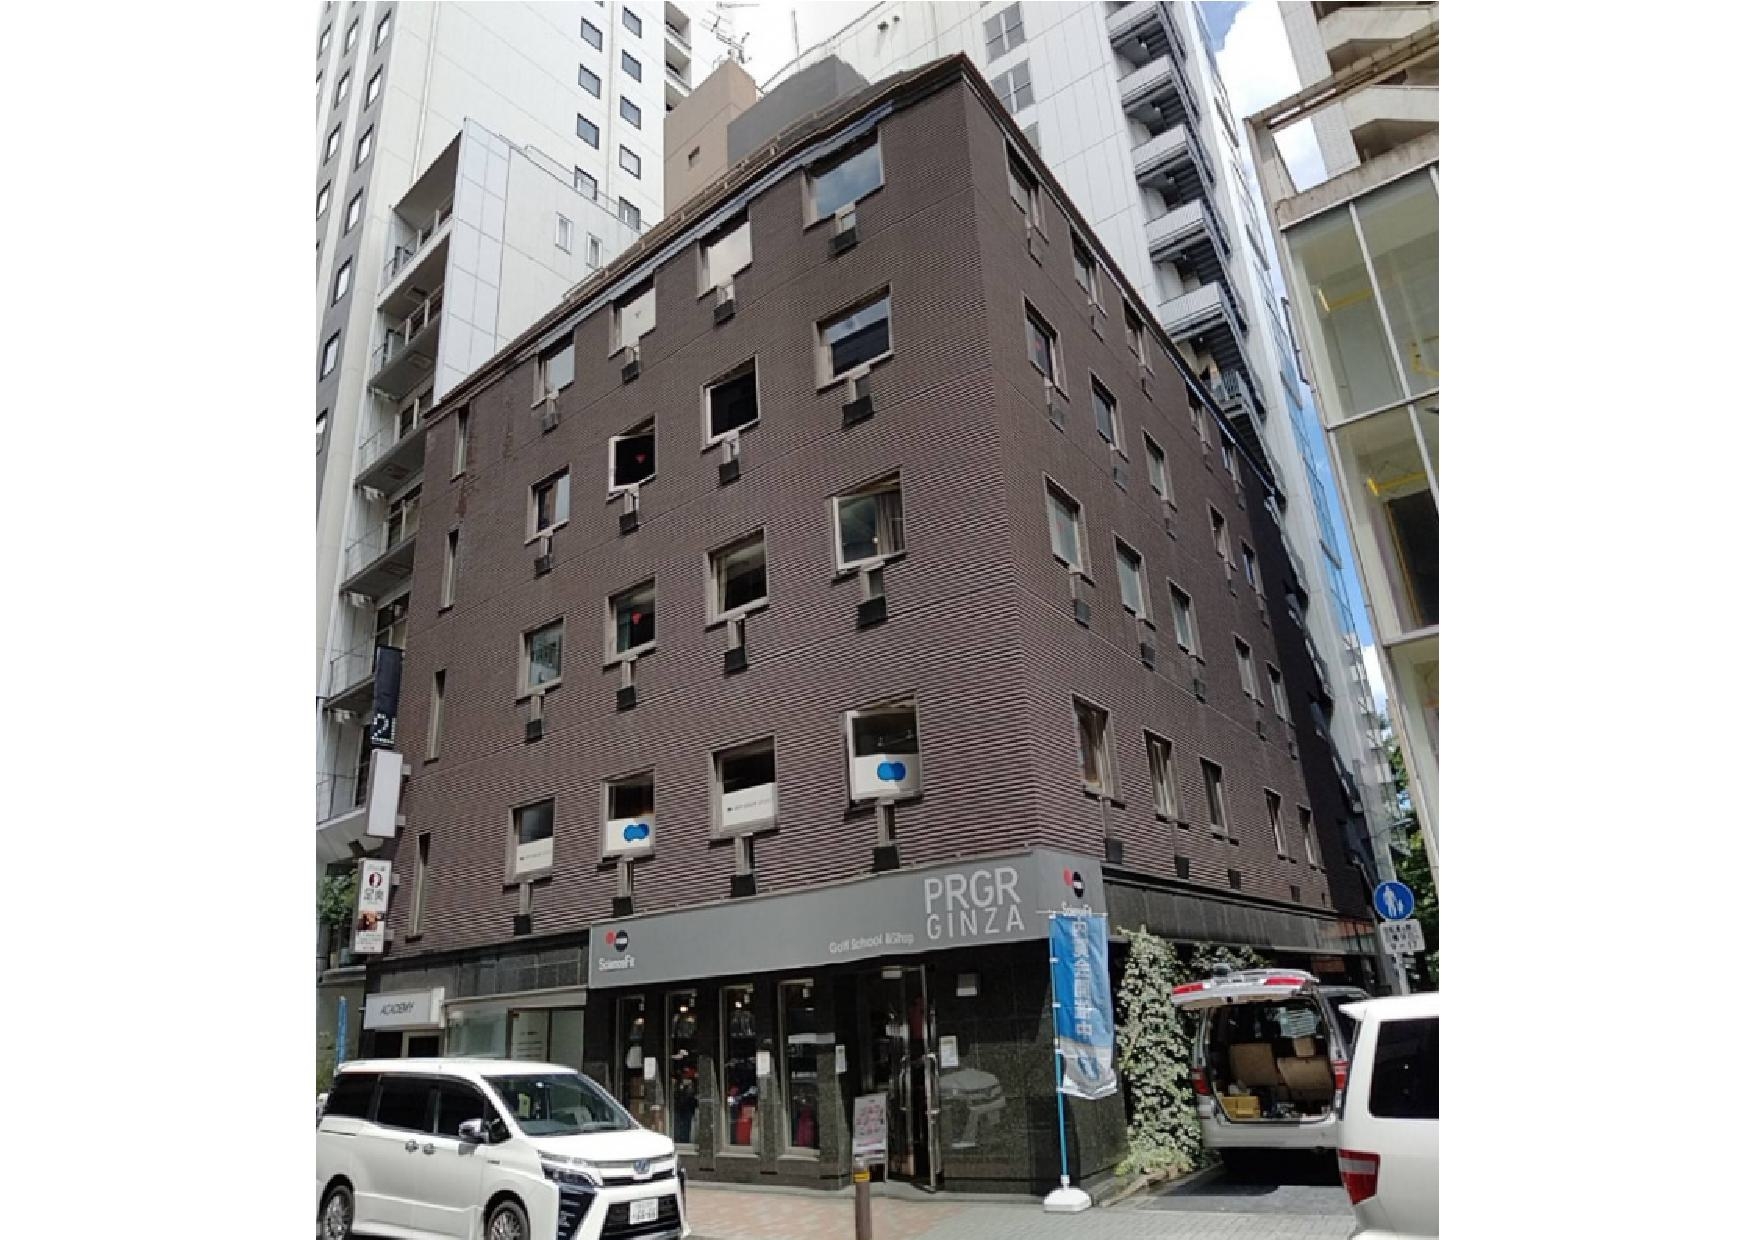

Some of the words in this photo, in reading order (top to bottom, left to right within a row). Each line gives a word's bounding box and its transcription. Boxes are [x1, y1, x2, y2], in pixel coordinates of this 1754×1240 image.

[924, 866, 1022, 914] PRGR
[926, 904, 1025, 940] GINZA
[829, 939, 850, 953] Golf
[851, 933, 883, 950] School
